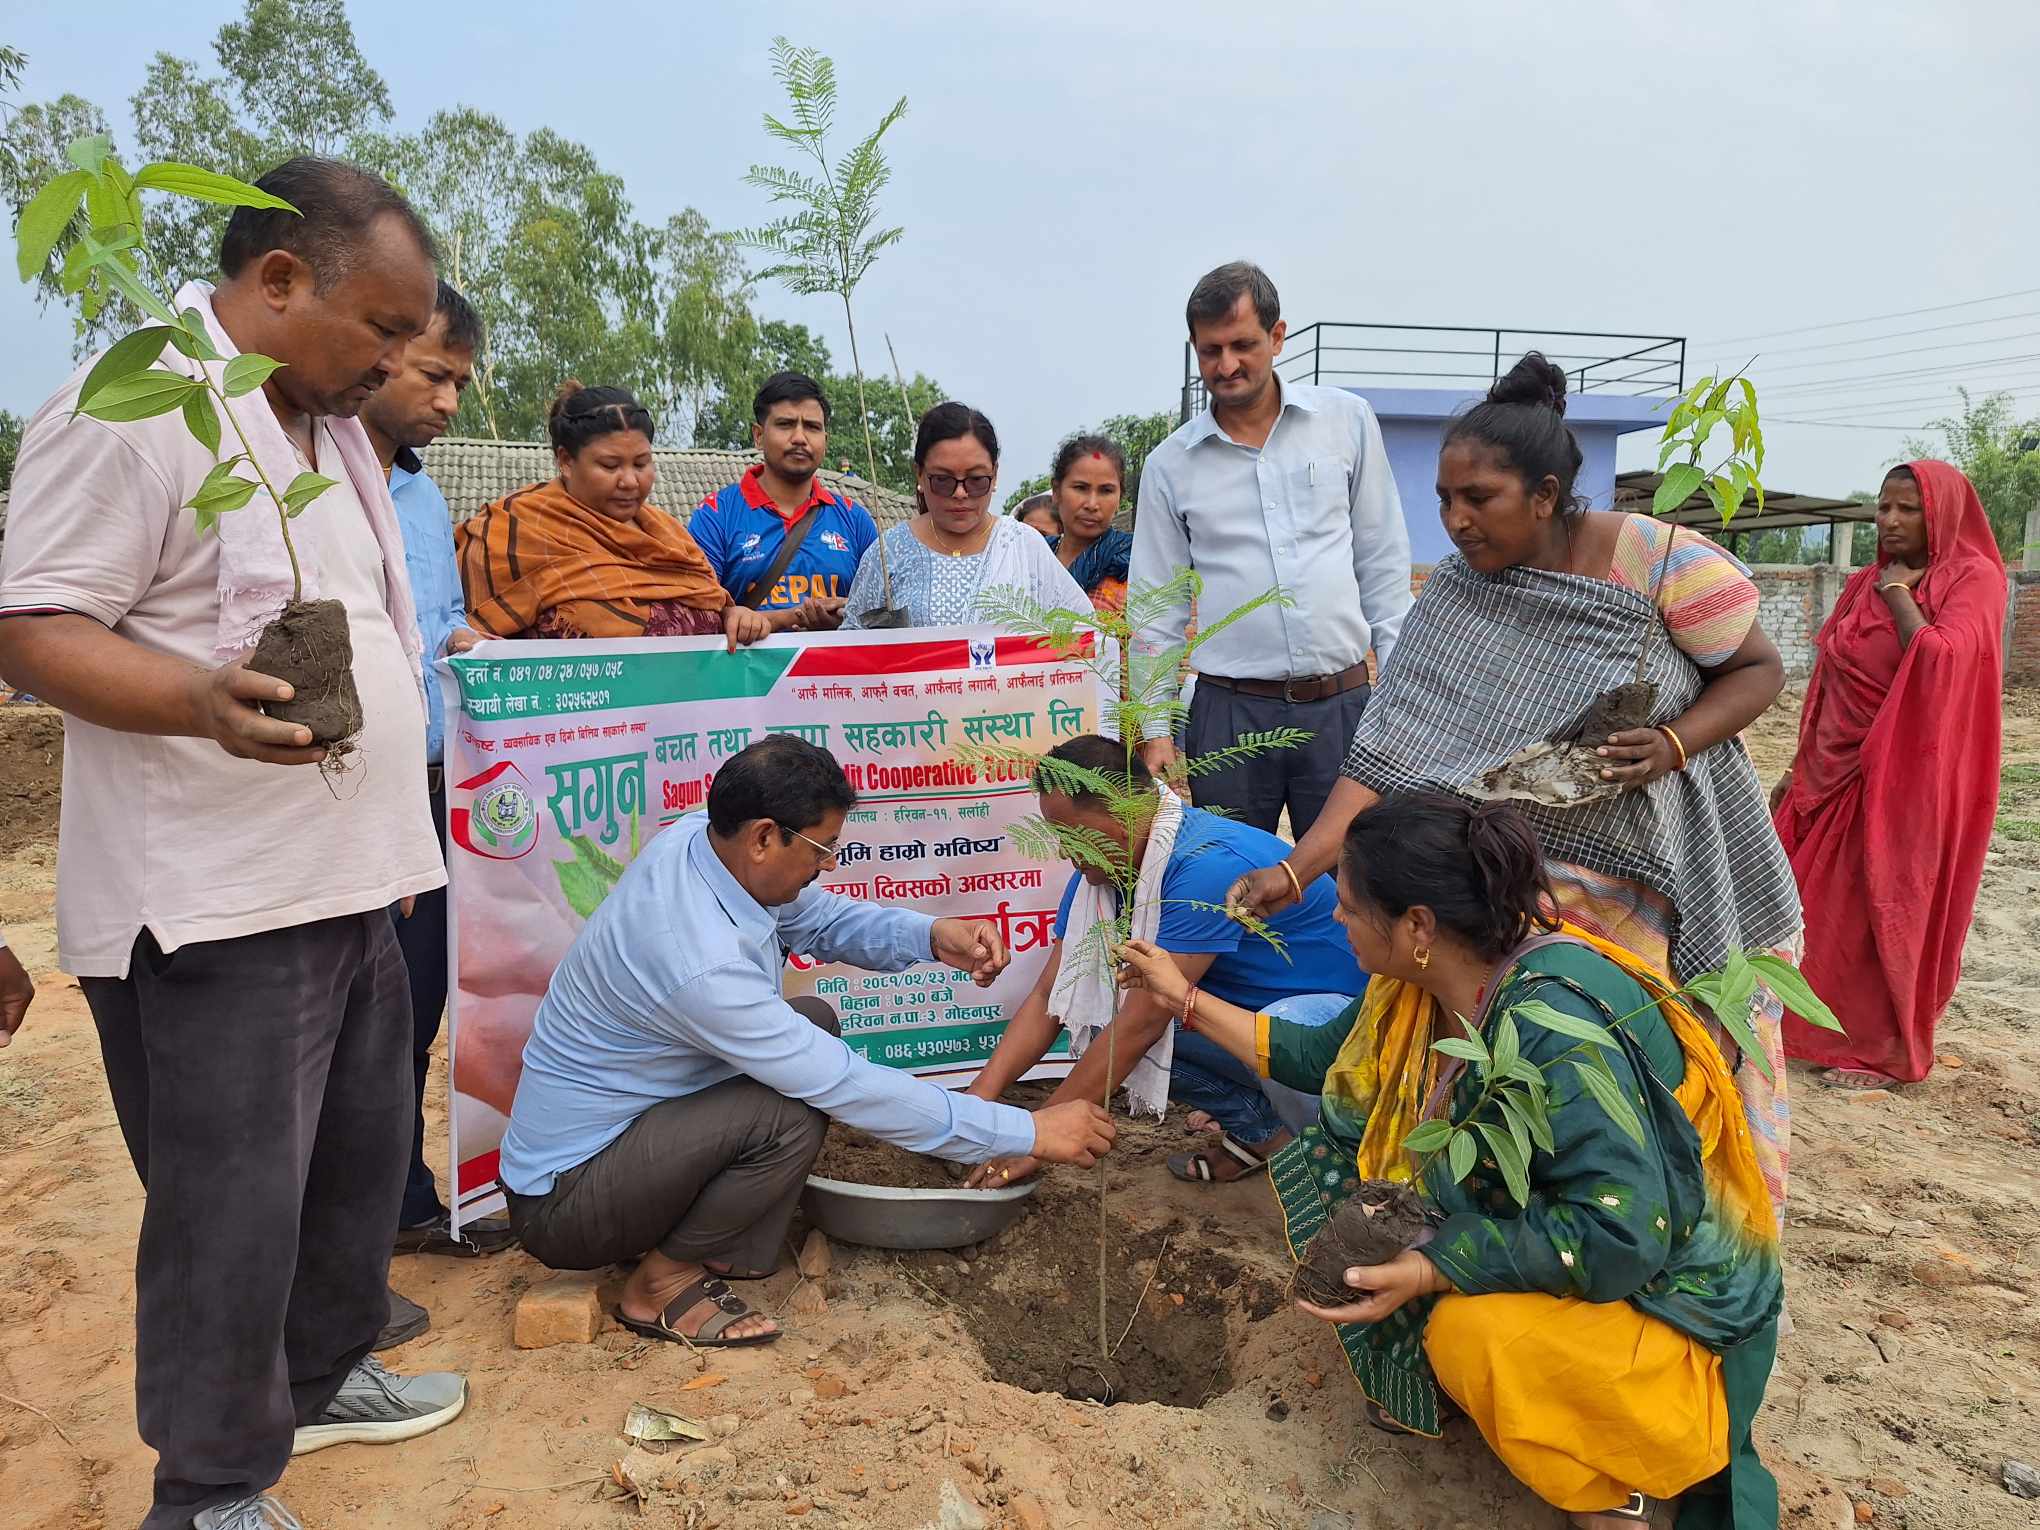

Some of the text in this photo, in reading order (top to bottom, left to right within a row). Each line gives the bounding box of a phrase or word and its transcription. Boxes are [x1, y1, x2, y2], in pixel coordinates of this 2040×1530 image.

[748, 574, 839, 605] EPAL
[466, 692, 501, 716] स्थायी
[505, 692, 528, 714] लेखा
[654, 733, 698, 764] बचत
[706, 728, 752, 759] तथा
[842, 709, 949, 755] सहकारी
[961, 709, 1035, 744] संस्था
[866, 758, 978, 792] Cooperative
[545, 751, 649, 845] सगुन
[663, 778, 702, 810] Sagun
[879, 840, 927, 861] हाम्रो
[875, 873, 951, 900] दिवसको
[958, 869, 1043, 894] अवसरमा
[816, 978, 849, 996] मिति
[863, 971, 947, 990] २०८१/०२/२३
[840, 994, 880, 1012] बिहान
[930, 986, 954, 1003] बजे
[840, 1013, 884, 1031] हरिवन
[945, 1003, 1001, 1021] मोहनपुर
